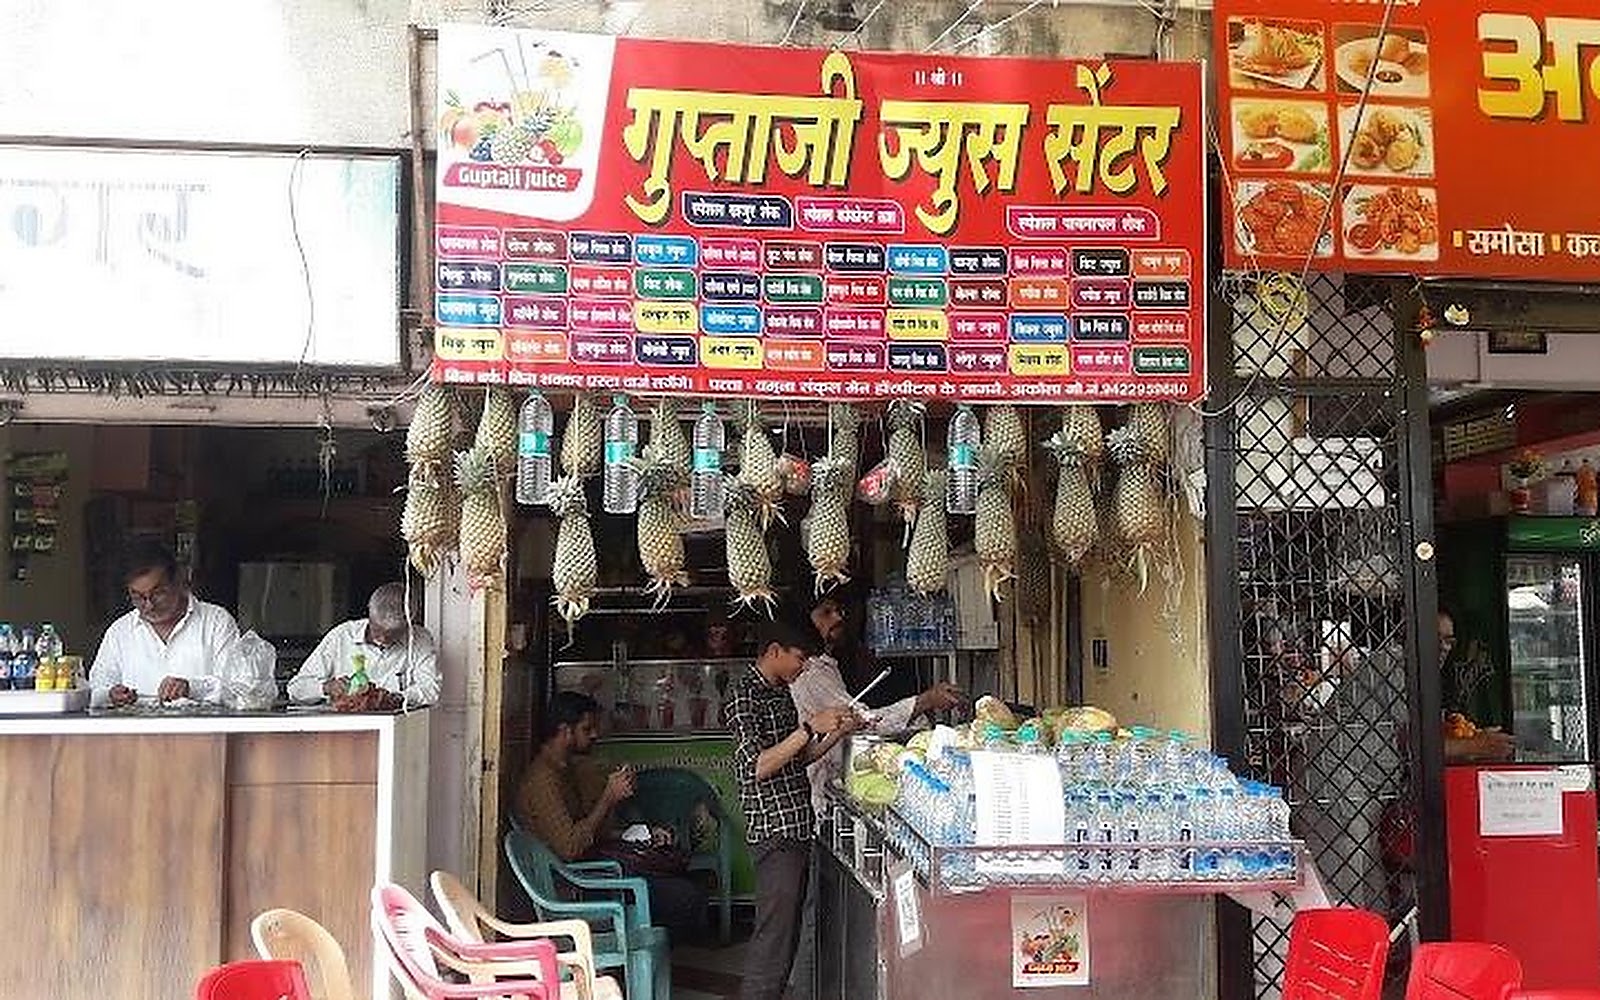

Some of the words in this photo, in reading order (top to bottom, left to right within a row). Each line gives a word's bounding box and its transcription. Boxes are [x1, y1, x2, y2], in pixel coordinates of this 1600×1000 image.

[1476, 12, 1600, 122] अ
[622, 51, 864, 226] गुप्ताजी
[878, 99, 1031, 236] ज्युस
[1044, 62, 1182, 196] सेंटर
[1466, 222, 1545, 256] समोसा
